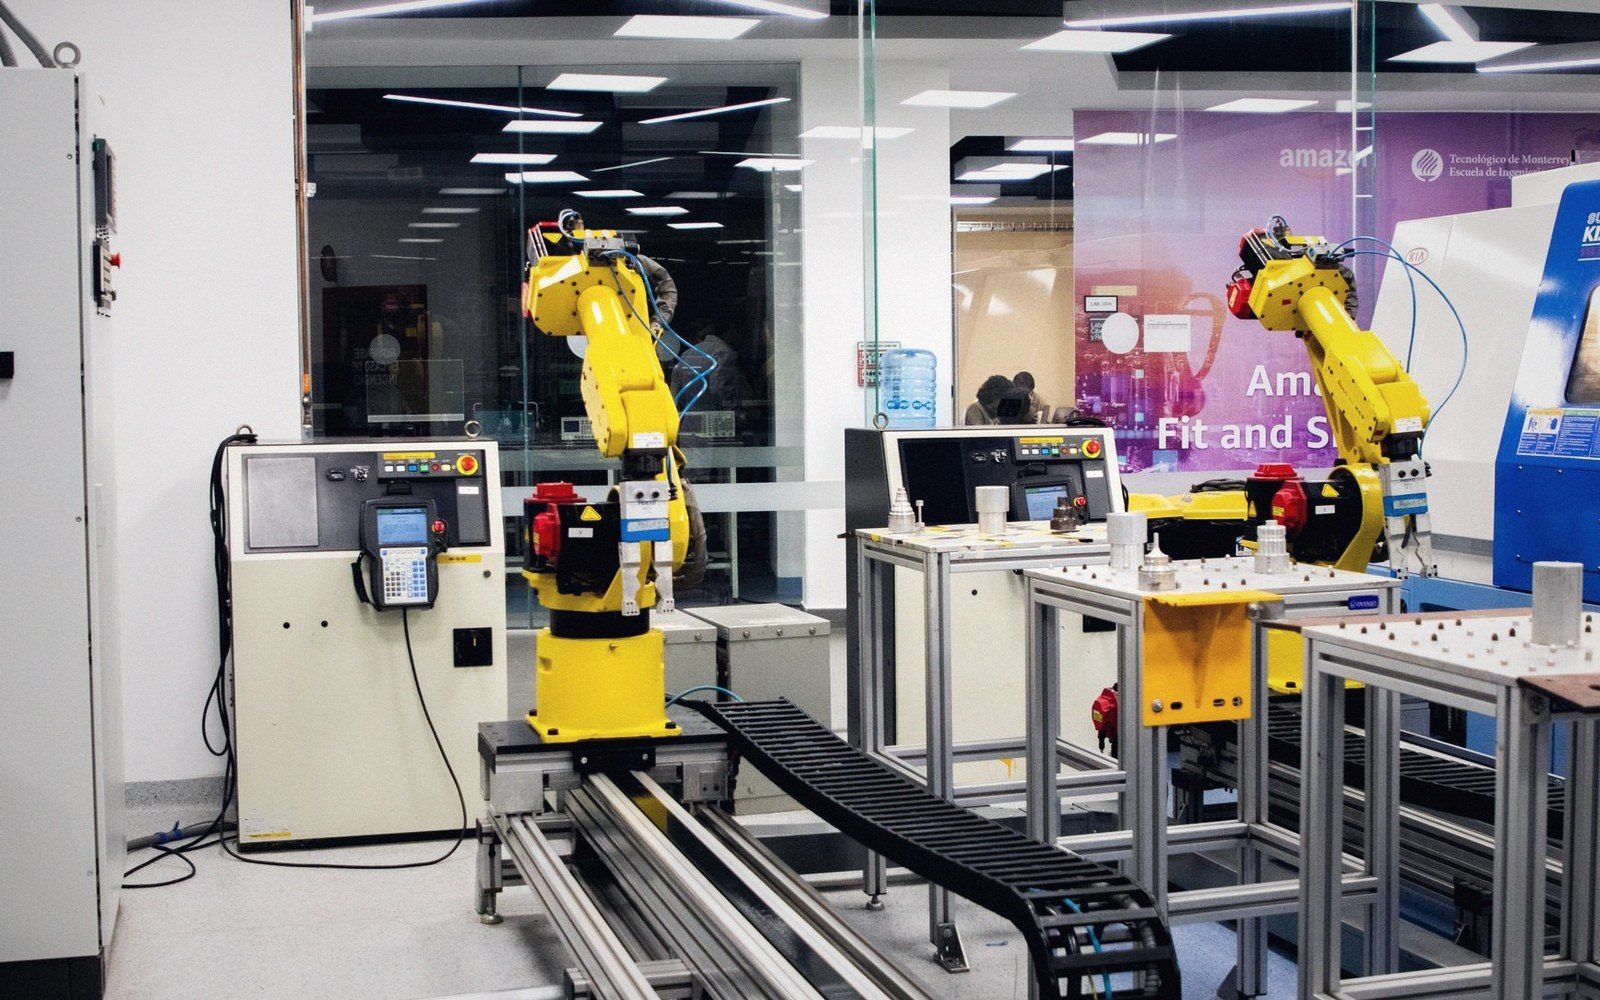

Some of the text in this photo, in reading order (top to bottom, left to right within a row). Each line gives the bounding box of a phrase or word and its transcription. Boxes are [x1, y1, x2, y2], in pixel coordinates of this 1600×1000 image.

[1449, 153, 1571, 167] Tecnológico de Monterrey
[1449, 167, 1484, 177] Escuela
[1486, 167, 1497, 177] de
[1158, 414, 1338, 450] Fit and S
